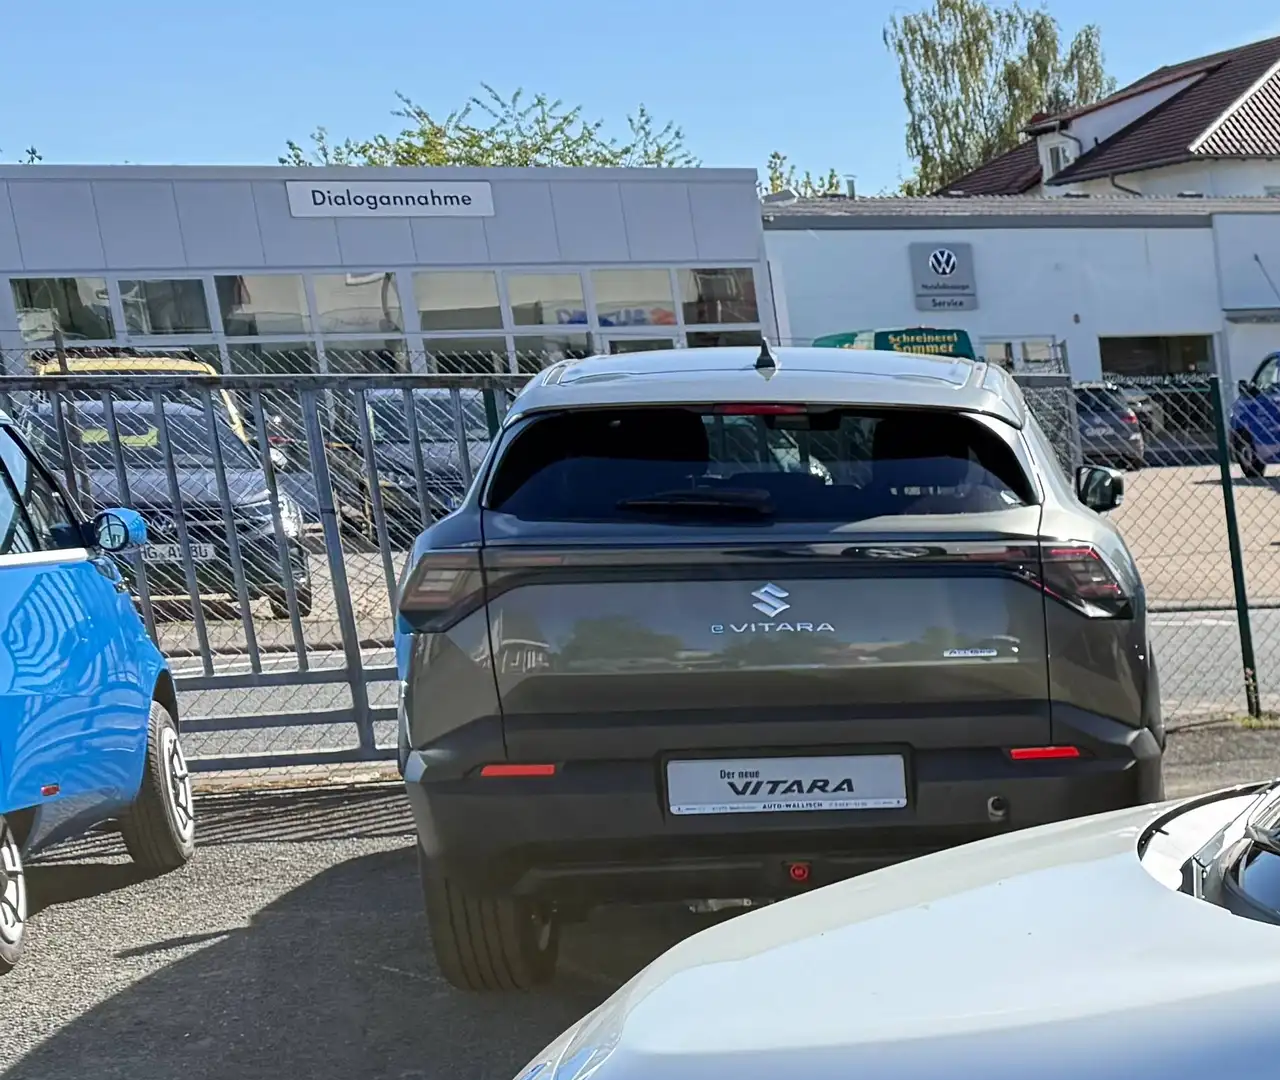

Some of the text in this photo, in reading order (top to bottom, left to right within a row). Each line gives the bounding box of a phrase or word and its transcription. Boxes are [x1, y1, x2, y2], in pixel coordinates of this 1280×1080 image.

[311, 189, 472, 210] Dialogannahme
[729, 622, 836, 633] VITARA
[719, 769, 760, 780] Der neue
[727, 778, 855, 796] VITARA
